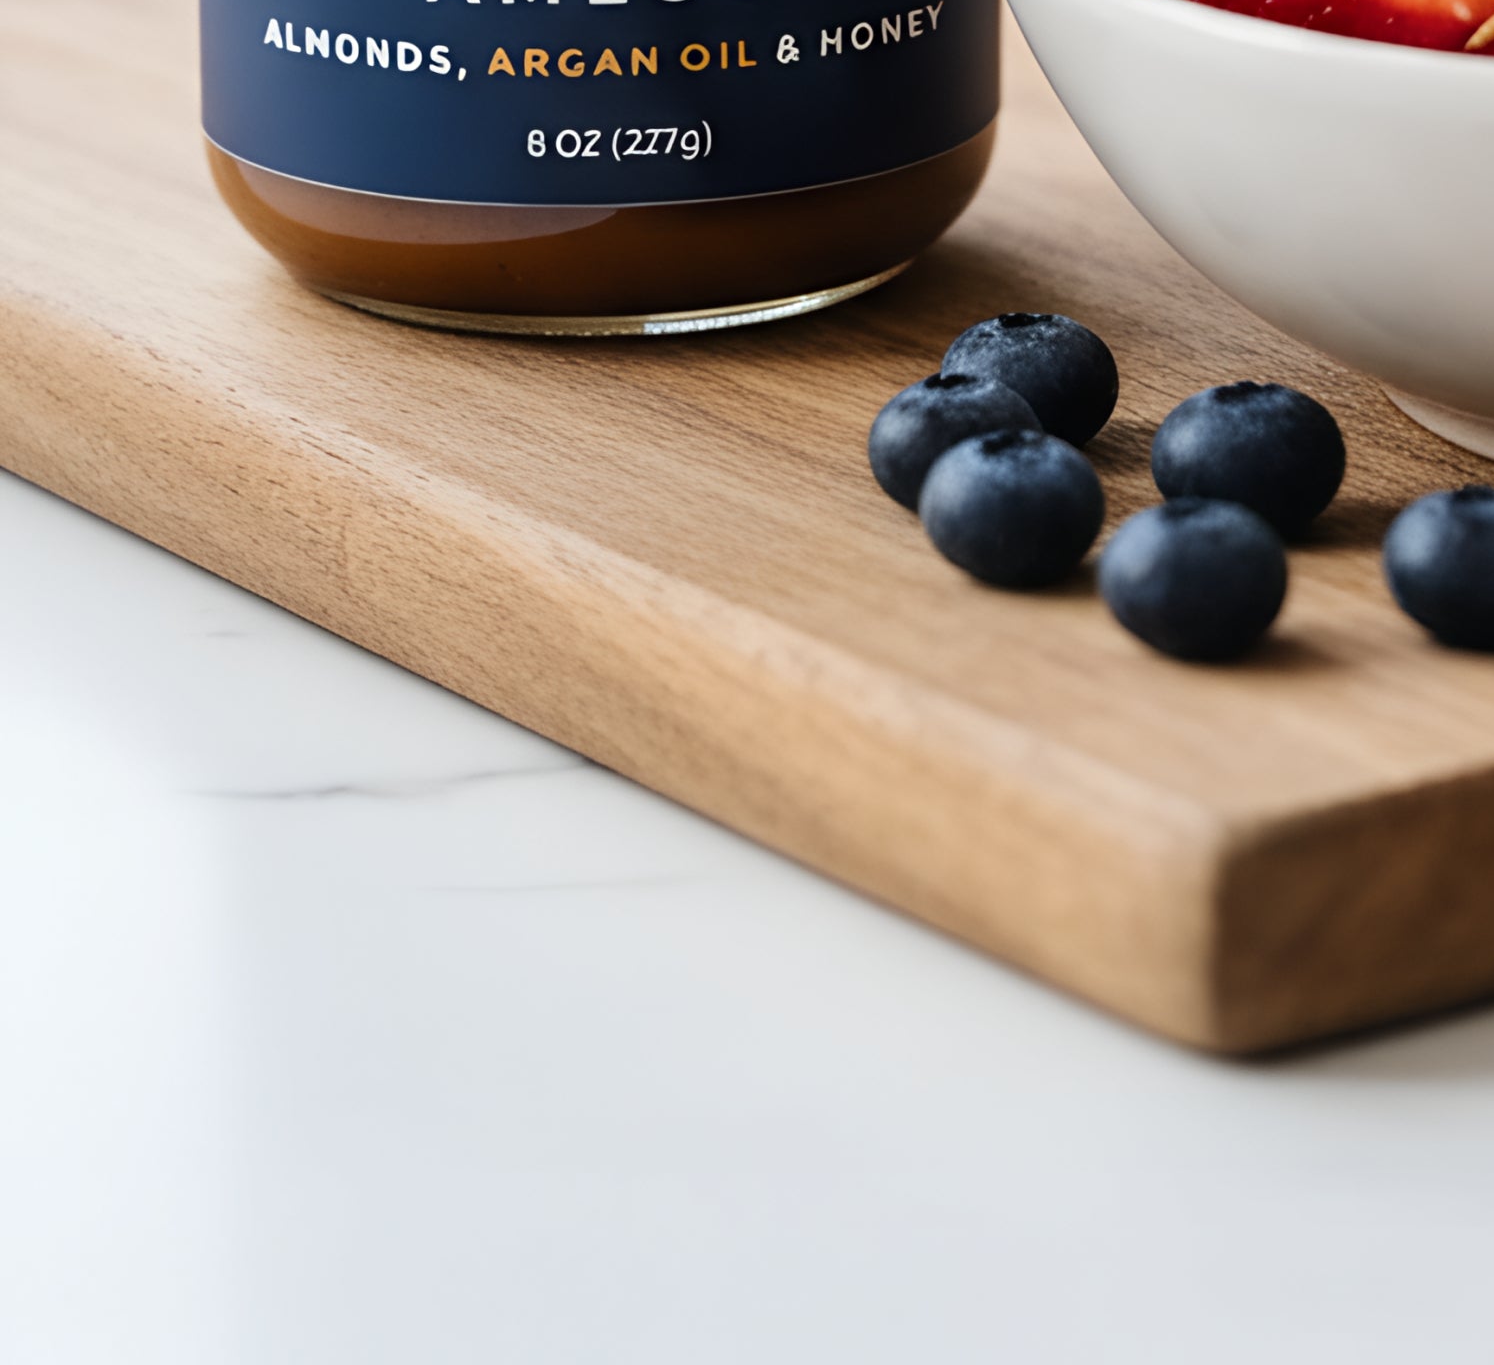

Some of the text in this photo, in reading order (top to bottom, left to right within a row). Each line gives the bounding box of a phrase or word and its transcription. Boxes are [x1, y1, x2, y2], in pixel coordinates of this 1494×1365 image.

[488, 47, 658, 77] ARGAN
[680, 40, 757, 71] OIL
[776, 34, 800, 64] &
[527, 129, 547, 157] 8
[556, 129, 602, 158] OZ
